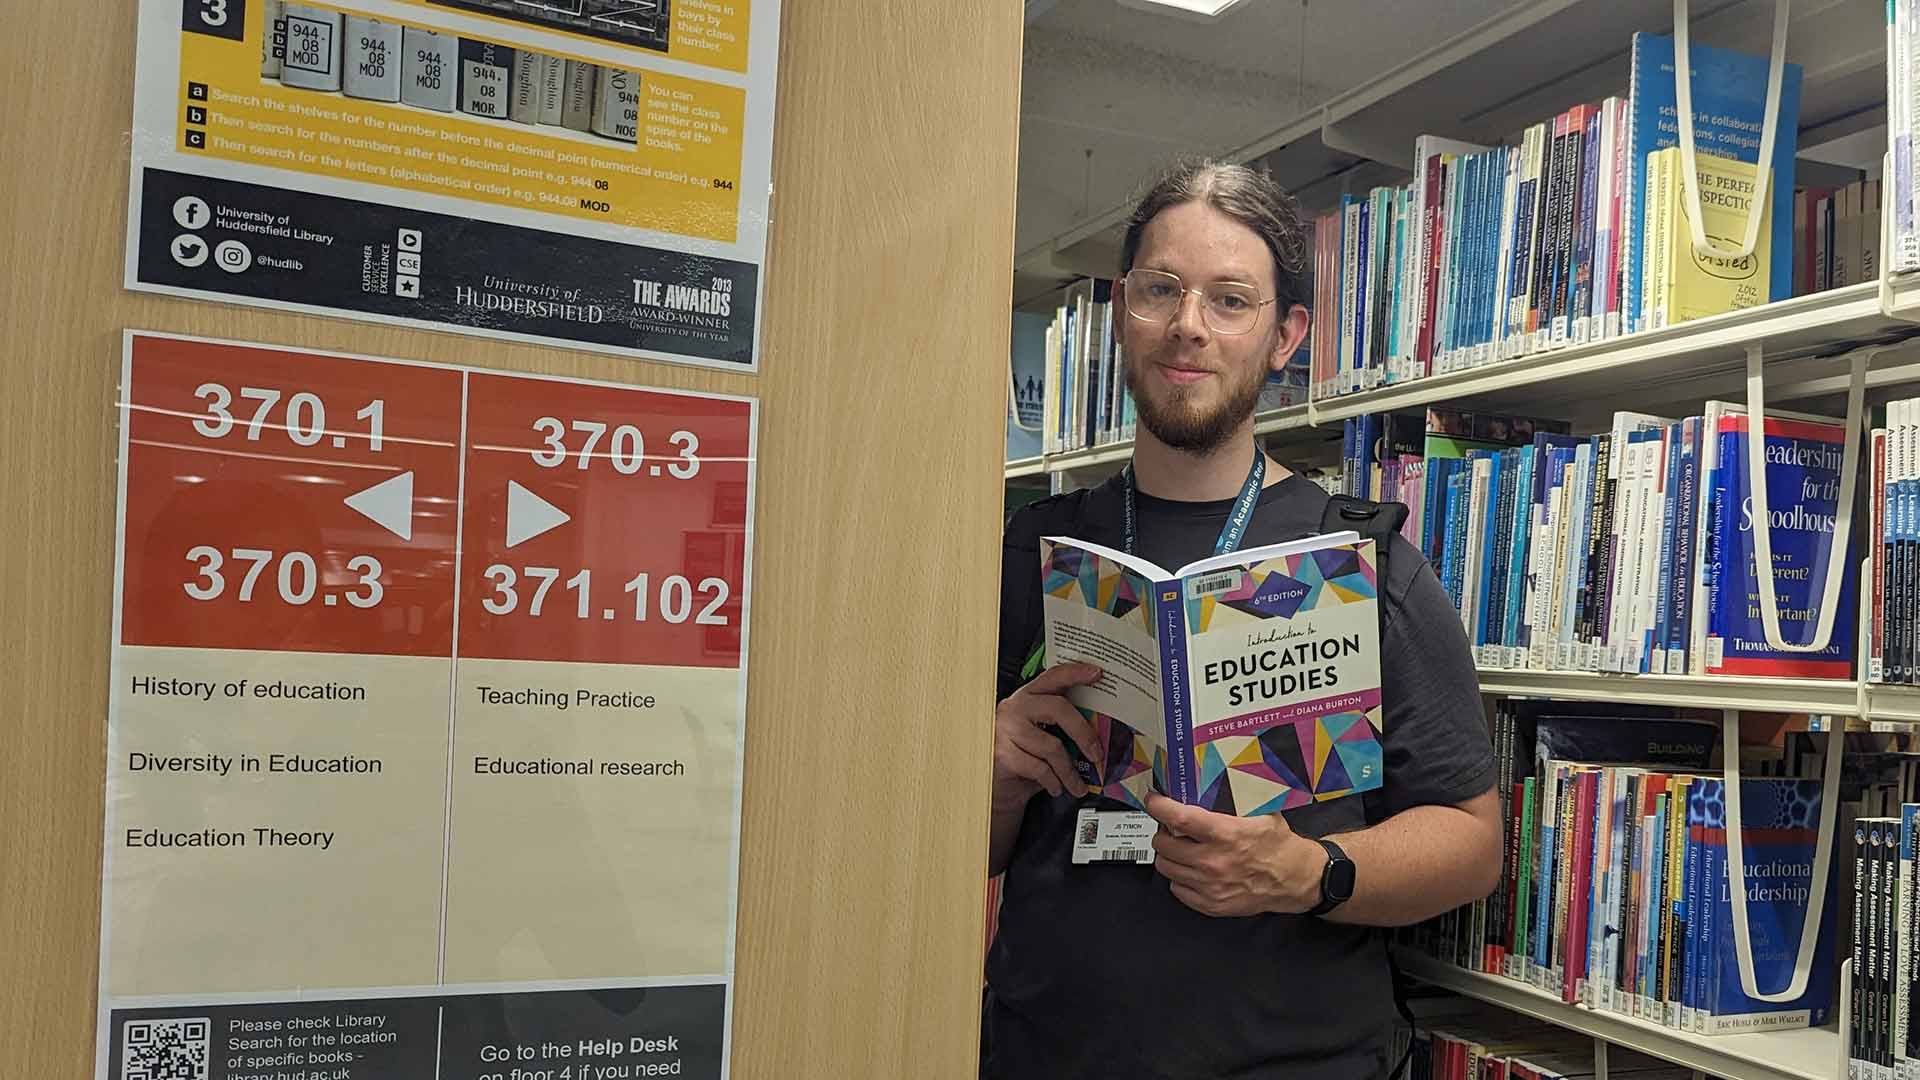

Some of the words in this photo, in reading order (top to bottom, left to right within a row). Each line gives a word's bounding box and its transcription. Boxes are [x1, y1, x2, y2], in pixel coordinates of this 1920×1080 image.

[200, 0, 228, 26] 3
[292, 50, 319, 66] MOD
[302, 39, 319, 53] 08
[368, 51, 385, 66] 08
[360, 63, 385, 78] MOD
[416, 75, 441, 90] MOD
[425, 64, 441, 78] 08
[480, 84, 496, 98] 08
[471, 100, 496, 115] MOR
[193, 86, 203, 97] a
[713, 178, 733, 192] 944
[190, 134, 200, 145] c
[580, 199, 610, 213] MOD
[216, 205, 275, 225] University
[277, 215, 290, 226] of
[216, 217, 290, 239] Huddersfield
[294, 229, 335, 247] Library
[257, 254, 304, 271] @hudlib
[362, 245, 373, 292] CUSTOMER
[380, 243, 391, 295] EXCELLENCE
[400, 258, 419, 270] CSE
[483, 275, 560, 300] University
[563, 288, 581, 303] of
[632, 279, 662, 307] THE
[664, 284, 731, 317] AWARDS
[712, 276, 732, 293] 2013
[456, 285, 602, 325] HUDDERSFIELD
[630, 307, 730, 330] AWARD-WINNER
[192, 383, 386, 452] 370.1
[530, 416, 701, 480] 370.3
[1887, 428, 1895, 480] Assessment
[1898, 425, 1907, 477] Assessment
[1910, 425, 1918, 477] Assessment
[1254, 462, 1264, 480] Rep
[1233, 480, 1258, 527] Academic
[1682, 464, 1692, 526] ORGANIZATIONAL
[1715, 487, 1726, 534] Leadership
[1622, 490, 1631, 536] EDUCATIONAL
[1640, 488, 1648, 536] EDUCATIONAL
[1885, 497, 1894, 536] Learning
[1896, 494, 1904, 534] Learning
[1907, 494, 1916, 534] Learning
[1229, 526, 1239, 540] an
[1679, 528, 1688, 564] BEHAVIOR
[184, 546, 384, 609] 370.3
[1710, 561, 1722, 614] Schoolhouse
[482, 564, 730, 626] 371.102
[1268, 588, 1304, 602] EDITION
[1676, 578, 1686, 619] EDUCATION
[1247, 626, 1304, 648] Introduction
[1204, 634, 1360, 686] EDUCATION
[132, 676, 216, 701] History
[224, 680, 248, 698] of
[254, 681, 366, 701] education
[477, 686, 569, 710] Teaching
[577, 690, 656, 708] Practice
[1228, 665, 1338, 706] STUDIES
[1208, 722, 1236, 736] STEVE
[1237, 711, 1281, 729] BARTLETT
[1282, 709, 1296, 720] and
[1296, 704, 1325, 716] DIANA
[1326, 696, 1362, 710] BURTON
[129, 753, 232, 776] Diversity
[241, 755, 260, 772] in
[269, 755, 382, 774] Education
[474, 757, 594, 776] Educational
[600, 759, 684, 776] research
[126, 828, 246, 848] Education
[253, 828, 334, 850] Theory
[1688, 846, 1698, 894] Educational
[1704, 849, 1713, 898] Educational
[1854, 858, 1864, 890] Making
[1870, 860, 1879, 892] Making
[1884, 861, 1893, 894] Making
[1686, 894, 1696, 938] Leadership
[1902, 872, 1911, 930] LEARNING
[1701, 899, 1712, 942] Leadership
[1854, 892, 1862, 946] Assessment
[1868, 894, 1877, 949] Assessment
[1882, 896, 1892, 951] Assessment
[1901, 933, 1909, 948] TO
[1853, 950, 1862, 976] Matter
[1867, 952, 1876, 978] Matter
[1882, 954, 1890, 981] Matter
[1900, 951, 1908, 979] LOVE
[230, 1018, 282, 1032] Please
[286, 1016, 331, 1031] check
[336, 1014, 386, 1031] Library
[1898, 982, 1907, 1048] ASSESSMENT
[228, 1036, 283, 1050] Search
[288, 1034, 306, 1048] for
[311, 1032, 336, 1046] the
[340, 1030, 397, 1045] location
[480, 1045, 511, 1062] Go
[516, 1044, 536, 1060] to
[542, 1042, 572, 1058] the
[578, 1038, 624, 1060] Help
[630, 1035, 678, 1053] Desk
[228, 1055, 246, 1069] of
[246, 1052, 305, 1070] specific
[308, 1050, 353, 1064] books
[509, 1068, 554, 1080] floor
[559, 1065, 571, 1080] 4
[578, 1064, 590, 1080] if
[595, 1064, 629, 1080] you
[635, 1058, 682, 1076] need
